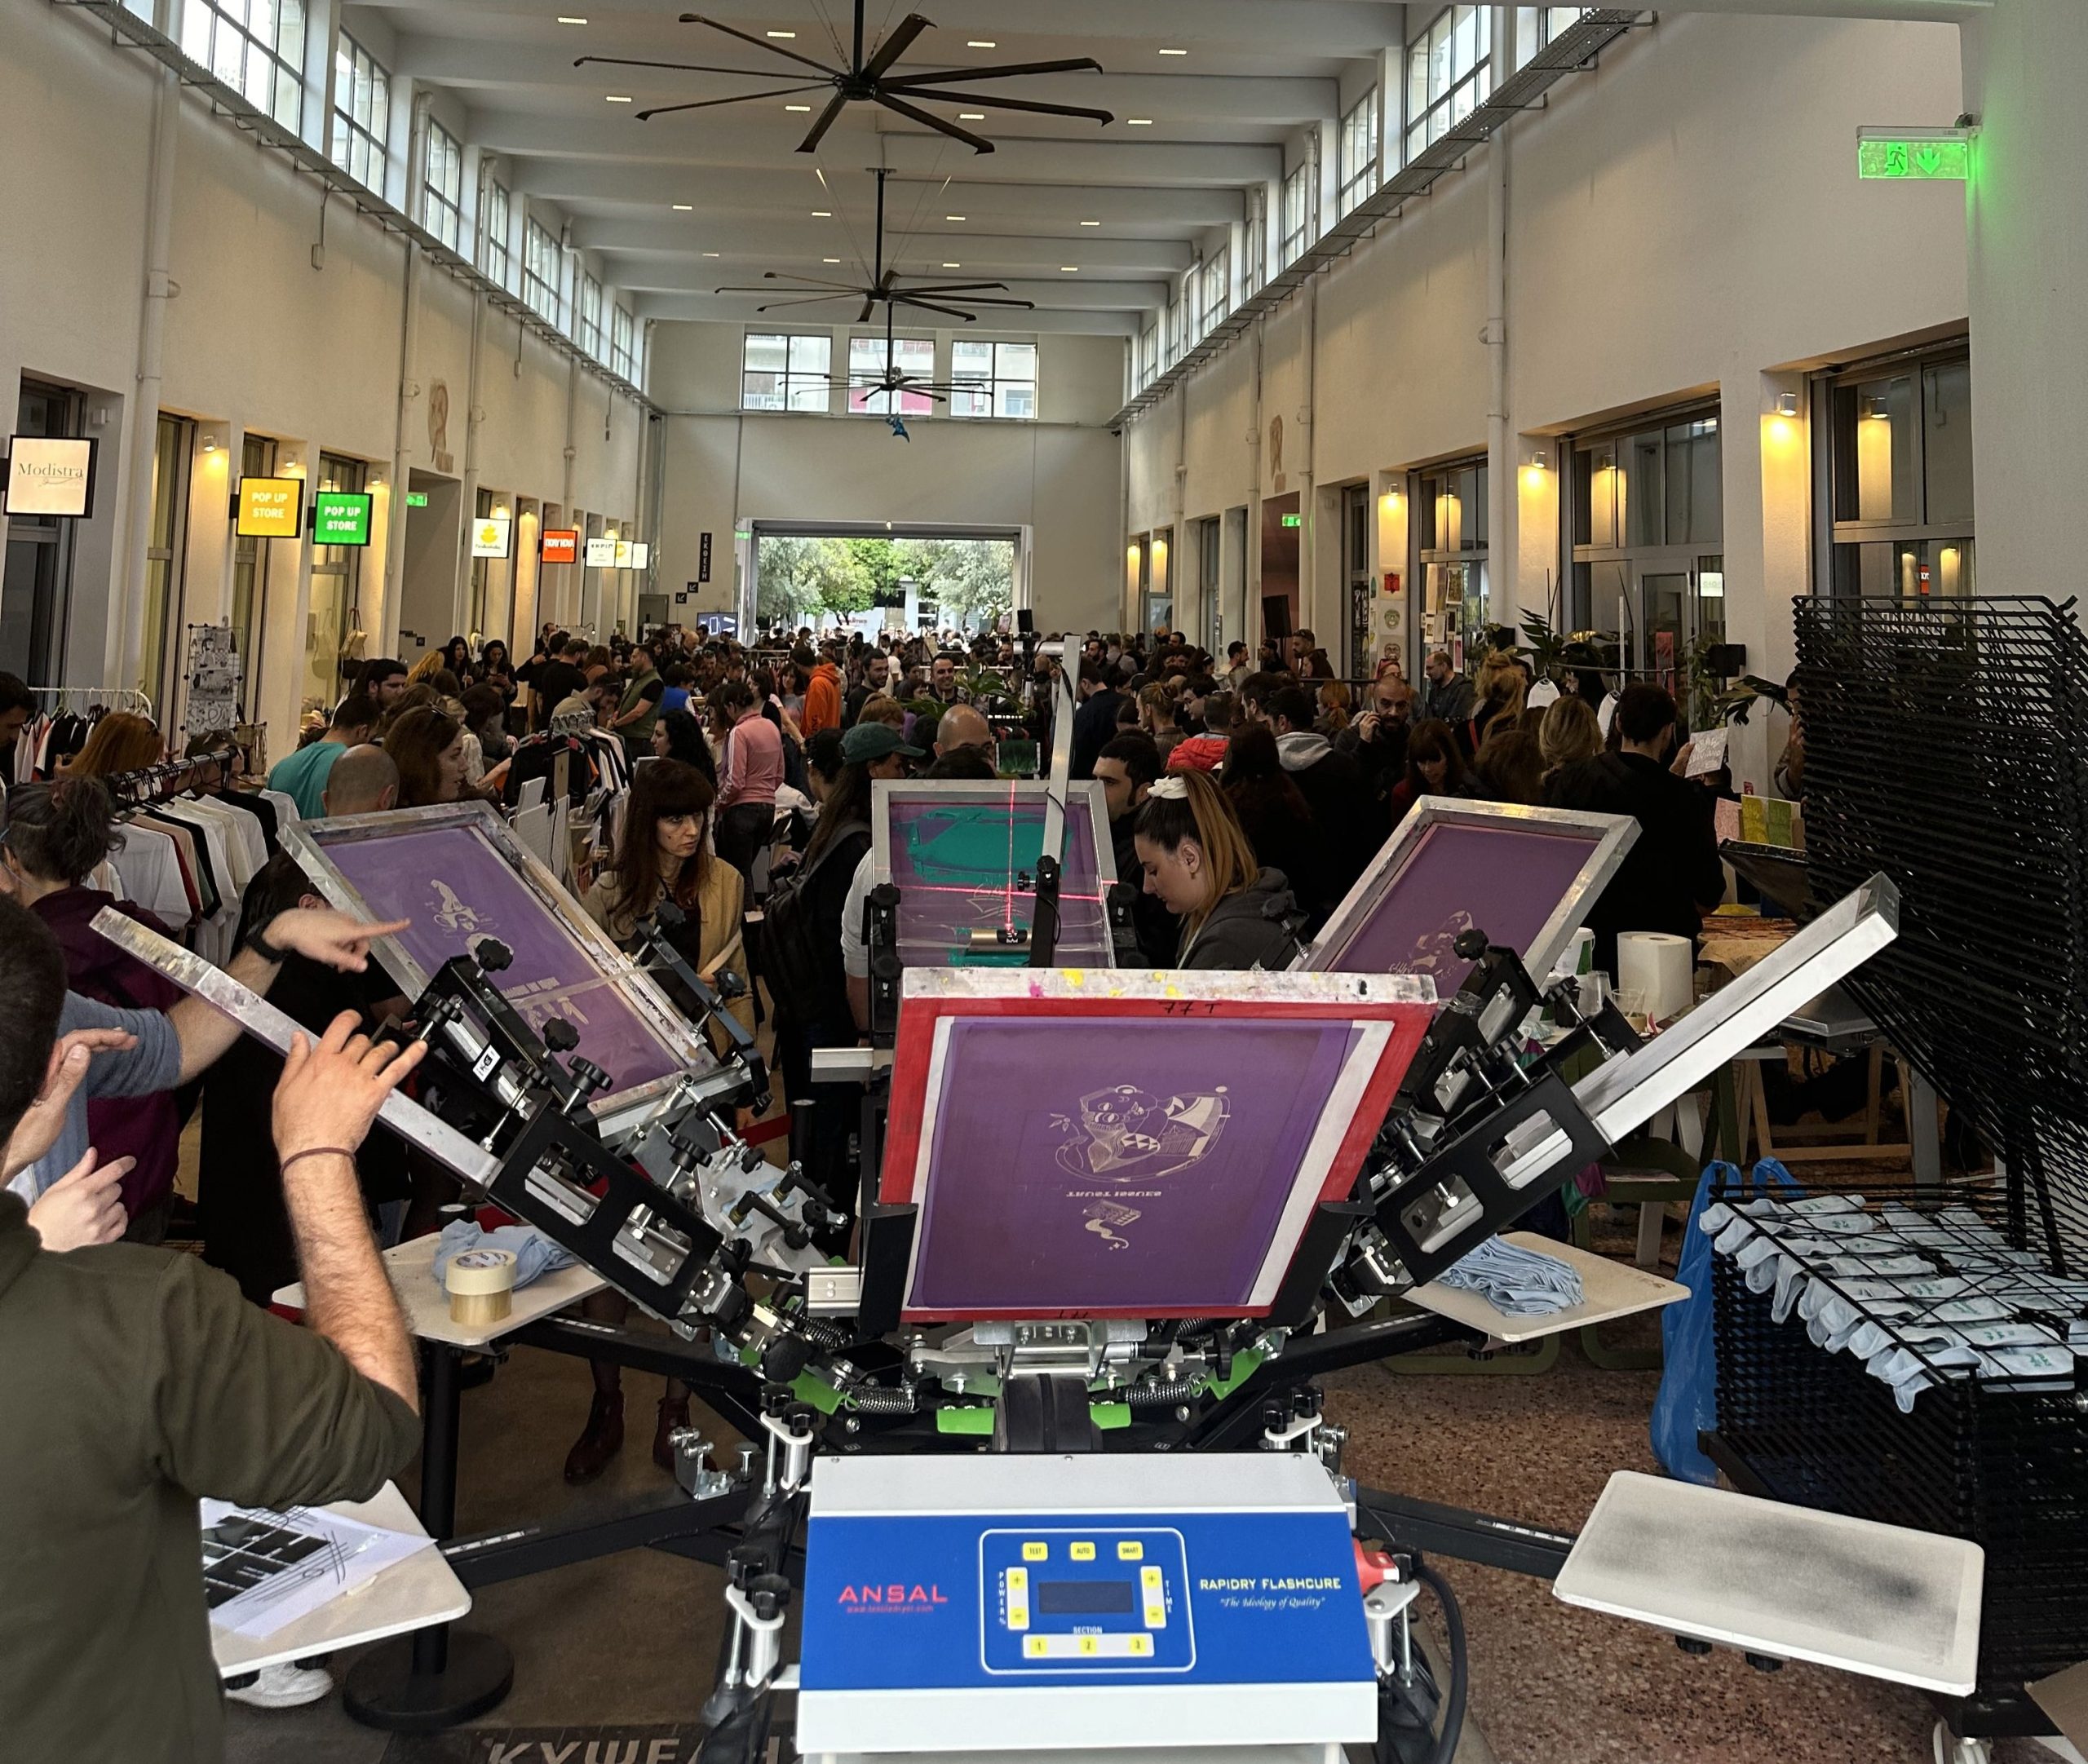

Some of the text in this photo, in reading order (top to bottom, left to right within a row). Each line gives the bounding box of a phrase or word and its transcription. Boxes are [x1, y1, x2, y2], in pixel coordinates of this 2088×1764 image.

[18, 462, 83, 480] Modistra
[251, 492, 288, 503] POP UP
[252, 507, 285, 519] STORE
[324, 506, 361, 517] POP UP
[326, 520, 357, 531] STORE
[1200, 1577, 1342, 1590] RAPIDRY FLASHCURE
[838, 1584, 948, 1604] ANSAL
[1165, 1580, 1173, 1613] TIME
[1242, 1597, 1276, 1610] Ideology
[1278, 1596, 1289, 1608] of
[1073, 1626, 1103, 1634] SECTION
